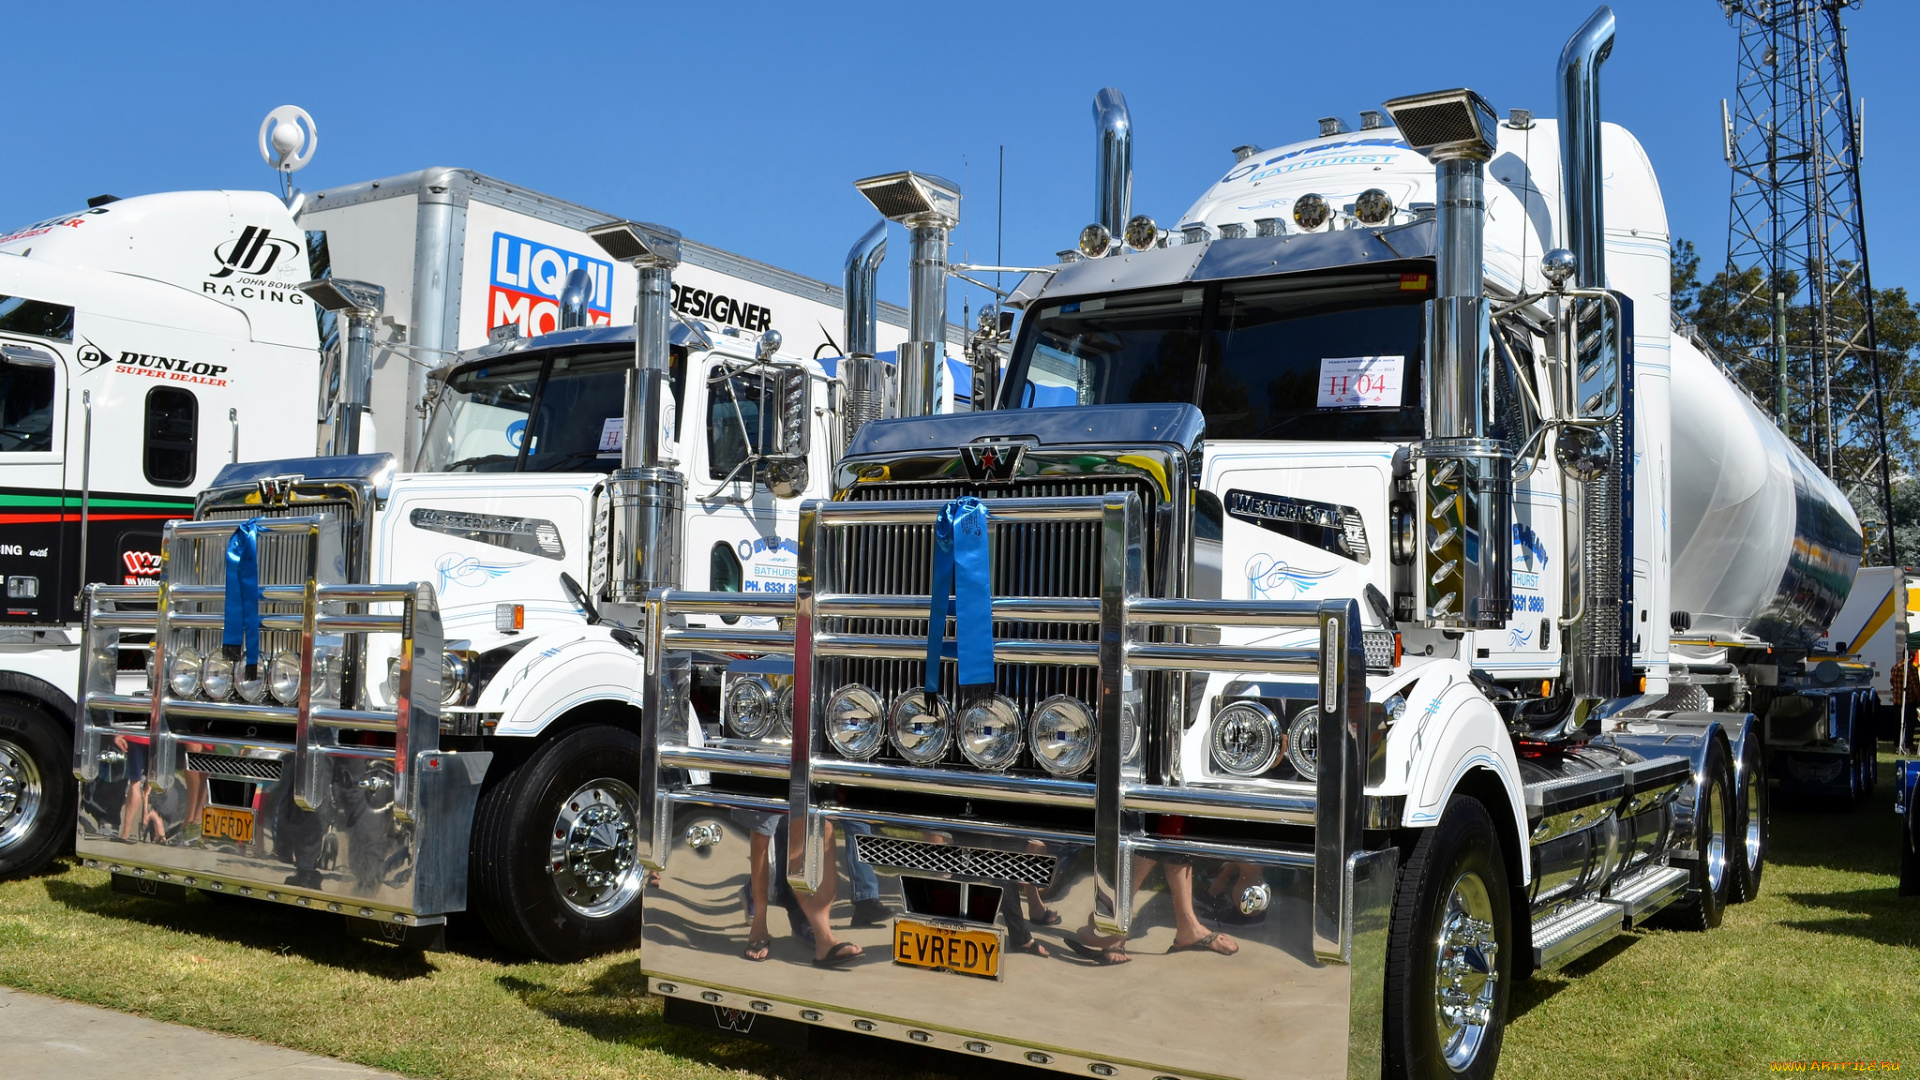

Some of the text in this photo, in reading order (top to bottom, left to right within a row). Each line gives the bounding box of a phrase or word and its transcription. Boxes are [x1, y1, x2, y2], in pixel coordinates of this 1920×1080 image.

[1249, 155, 1398, 182] BATHURST
[236, 277, 300, 291] JOHN BOWE
[496, 237, 609, 308] LIQUI
[203, 281, 304, 305] RACING
[670, 283, 772, 333] DESIGNER
[116, 351, 228, 377] DUNLOP
[115, 365, 227, 387] SUPER DEALER
[1328, 374, 1386, 396] H 04
[0, 544, 23, 556] ING
[754, 566, 797, 578] BATHURS
[1512, 572, 1539, 587] THURST
[745, 580, 761, 592] PH.
[764, 581, 786, 593] 6331
[204, 814, 252, 839] EVERDY
[899, 930, 996, 972] EVREDY
